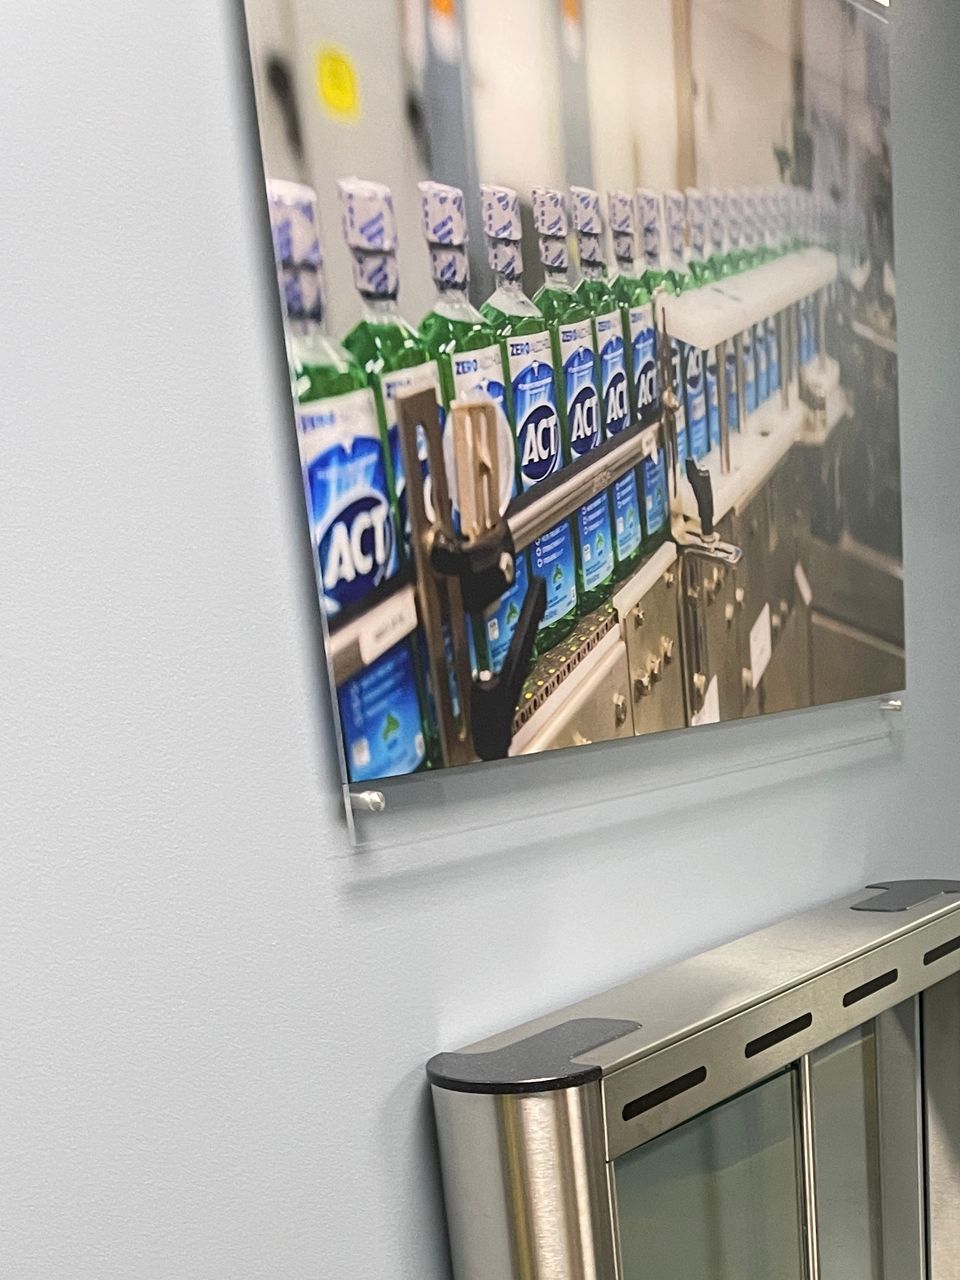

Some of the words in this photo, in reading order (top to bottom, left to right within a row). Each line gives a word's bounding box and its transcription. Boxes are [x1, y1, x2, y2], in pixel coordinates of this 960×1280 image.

[455, 359, 478, 376] ZERO
[510, 342, 531, 357] ZERO
[521, 414, 558, 467] ACT
[570, 395, 599, 442] ACT
[323, 503, 390, 590] ACT
